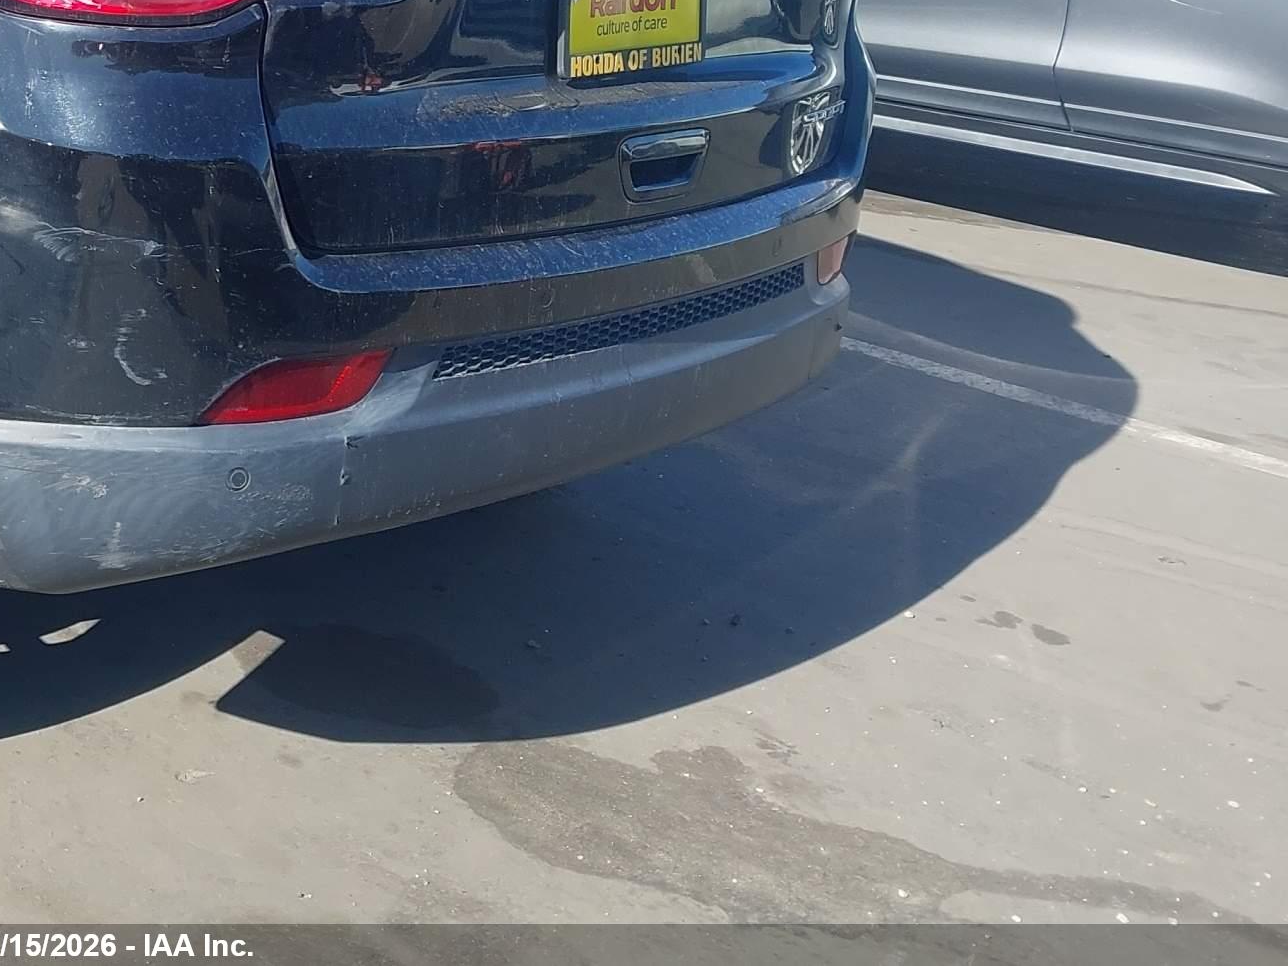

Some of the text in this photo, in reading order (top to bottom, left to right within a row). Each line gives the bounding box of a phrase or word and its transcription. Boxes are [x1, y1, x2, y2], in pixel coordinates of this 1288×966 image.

[596, 16, 668, 36] culture of care
[570, 42, 702, 77] HONDA OF BURIEN
